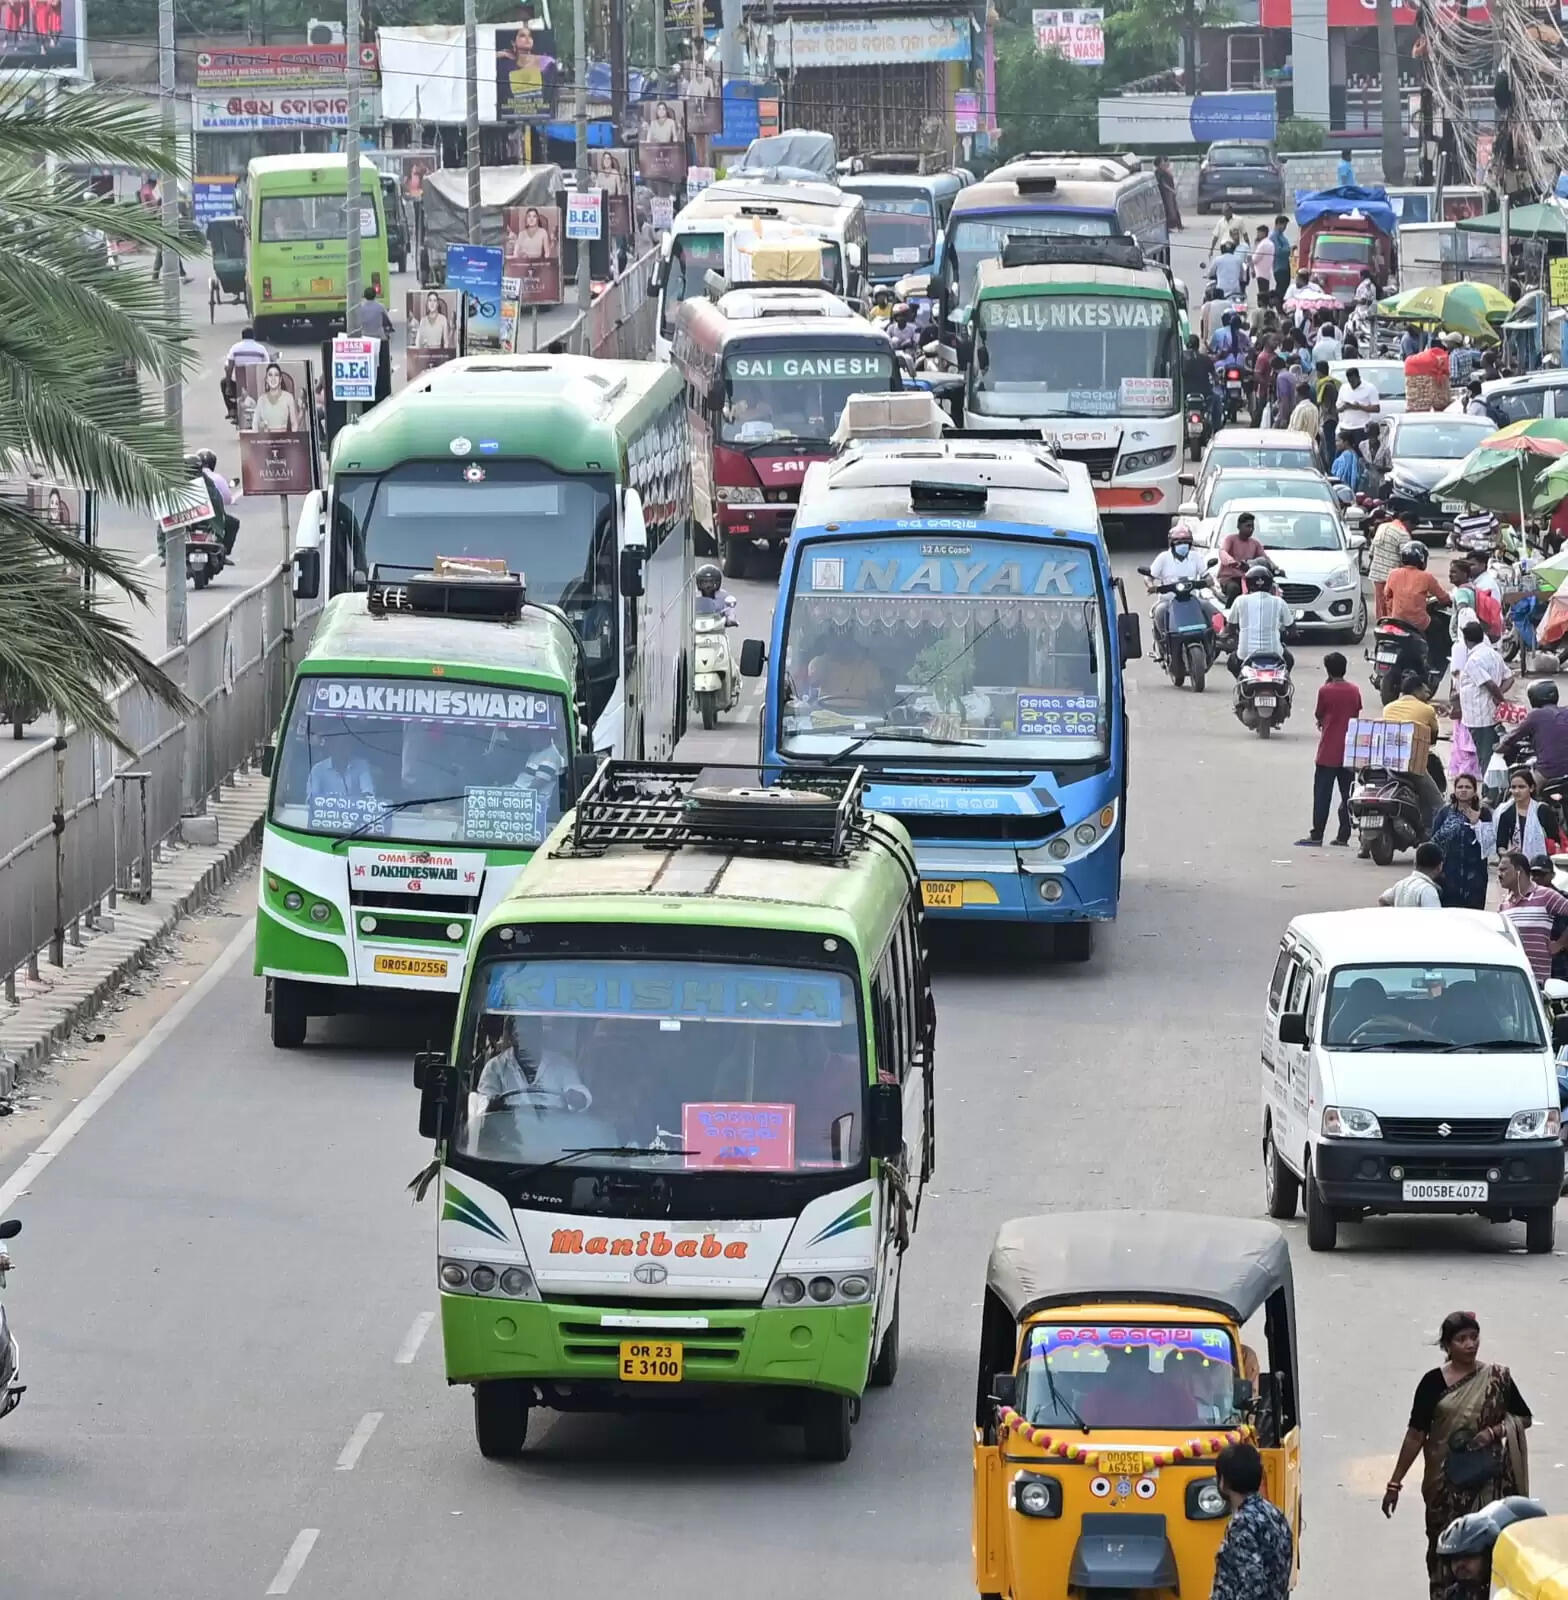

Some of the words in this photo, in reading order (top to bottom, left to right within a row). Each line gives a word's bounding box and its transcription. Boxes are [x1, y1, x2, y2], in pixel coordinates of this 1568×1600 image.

[1074, 42, 1104, 57] WASH
[569, 210, 597, 223] B.Ed
[335, 361, 369, 379] B.Ed
[736, 359, 773, 376] SAI
[783, 358, 880, 375] GANESH
[772, 461, 805, 473] SAI
[857, 560, 1077, 595] NAYAK
[328, 684, 536, 720] DAKHINESWARI
[378, 853, 406, 863] OMM
[371, 864, 458, 881] DAKHINESWARI
[926, 884, 956, 895] OD04P
[928, 894, 953, 906] 2441
[382, 958, 446, 974] OR05AD2556
[504, 977, 831, 1017] KRISHNA
[1411, 1185, 1485, 1199] OD05BE4072
[549, 1228, 748, 1259] Manibaba
[1056, 1327, 1100, 1342] ଜୟ
[1109, 1328, 1191, 1344] ଜଗନ୍ନାଥ
[630, 1345, 651, 1357] OR
[655, 1345, 673, 1358] 23
[623, 1360, 634, 1374] E
[639, 1361, 679, 1376] 3100
[1108, 1462, 1140, 1473] A6436
